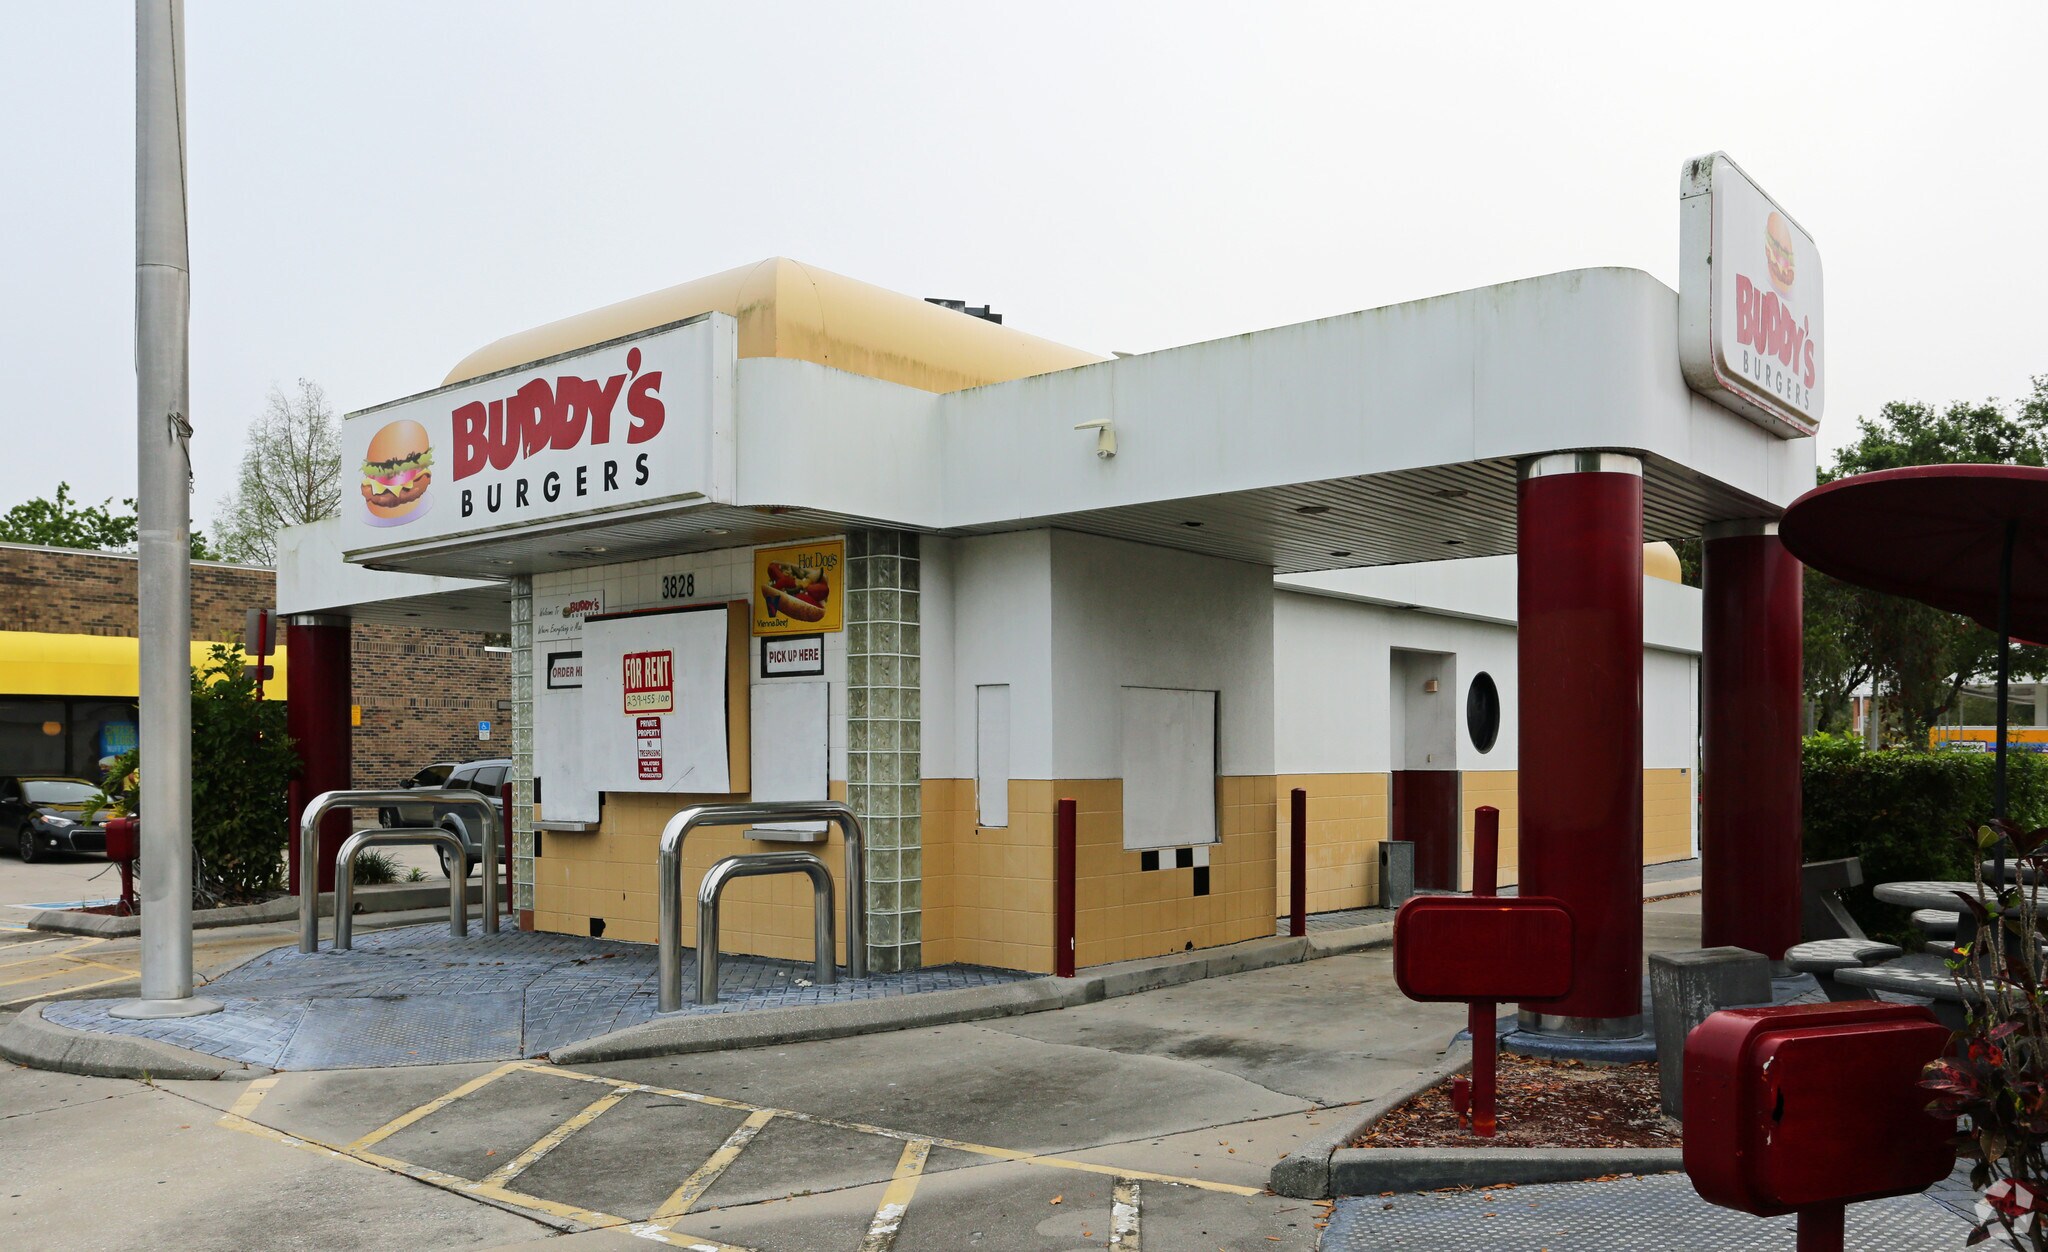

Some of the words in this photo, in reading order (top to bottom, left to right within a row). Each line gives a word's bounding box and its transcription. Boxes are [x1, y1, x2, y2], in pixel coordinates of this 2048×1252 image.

[1736, 273, 1816, 390] BUDDY'S
[1743, 349, 1810, 410] BURGERS
[451, 346, 666, 482] BUDDY'S
[461, 453, 650, 518] BURGERS
[798, 553, 813, 569] Hot
[662, 573, 694, 599] 3828
[570, 598, 600, 614] BUDDY'S
[757, 620, 776, 628] Vienna
[769, 650, 786, 663] PICK
[787, 650, 797, 662] UP
[799, 648, 819, 661] HERE
[552, 666, 574, 678] ORDER
[625, 657, 642, 689] FOR
[645, 655, 670, 688] RENT
[640, 719, 657, 728] PRIVATE
[637, 729, 660, 737] PROPERTY
[646, 740, 652, 748] NO
[639, 749, 661, 757] TRESPASSING
